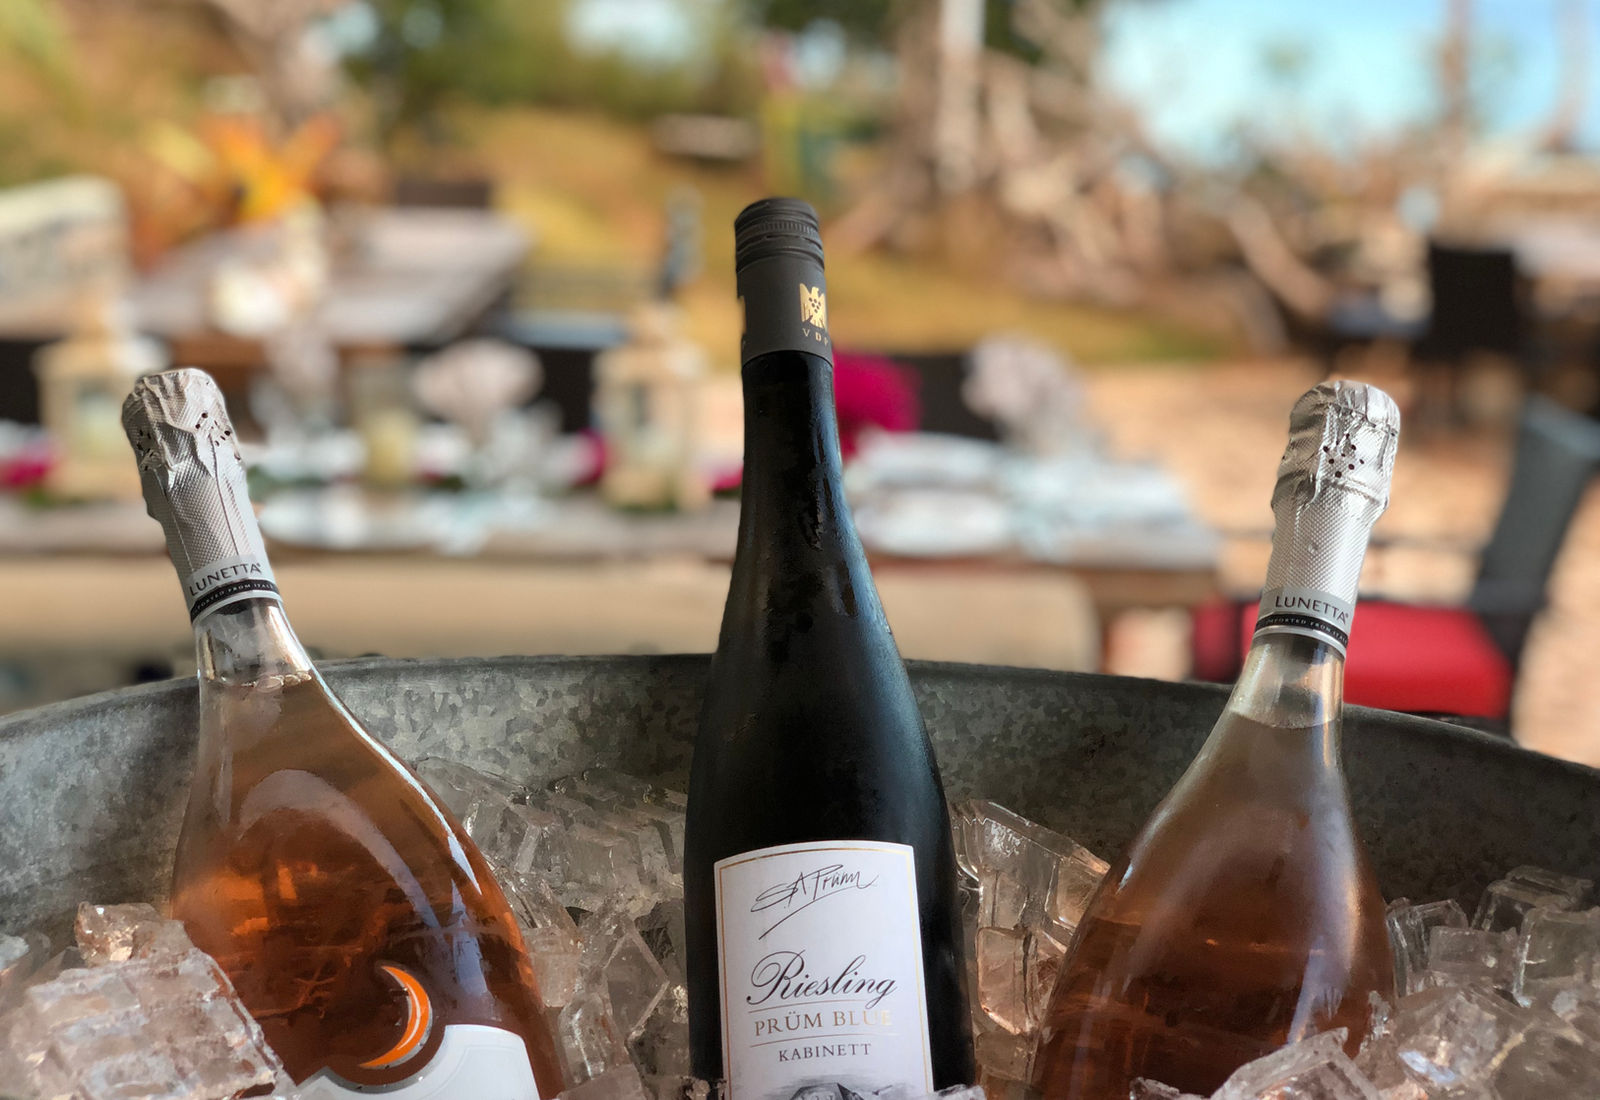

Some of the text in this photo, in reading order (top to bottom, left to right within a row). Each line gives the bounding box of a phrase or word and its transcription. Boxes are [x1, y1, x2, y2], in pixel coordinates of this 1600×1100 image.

[189, 563, 261, 597] LUNETTA
[1275, 595, 1347, 625] LUNETTA
[746, 950, 898, 1010] Riesling
[755, 1009, 893, 1037] PRÜM BLUE
[778, 1043, 871, 1062] KABINETT
